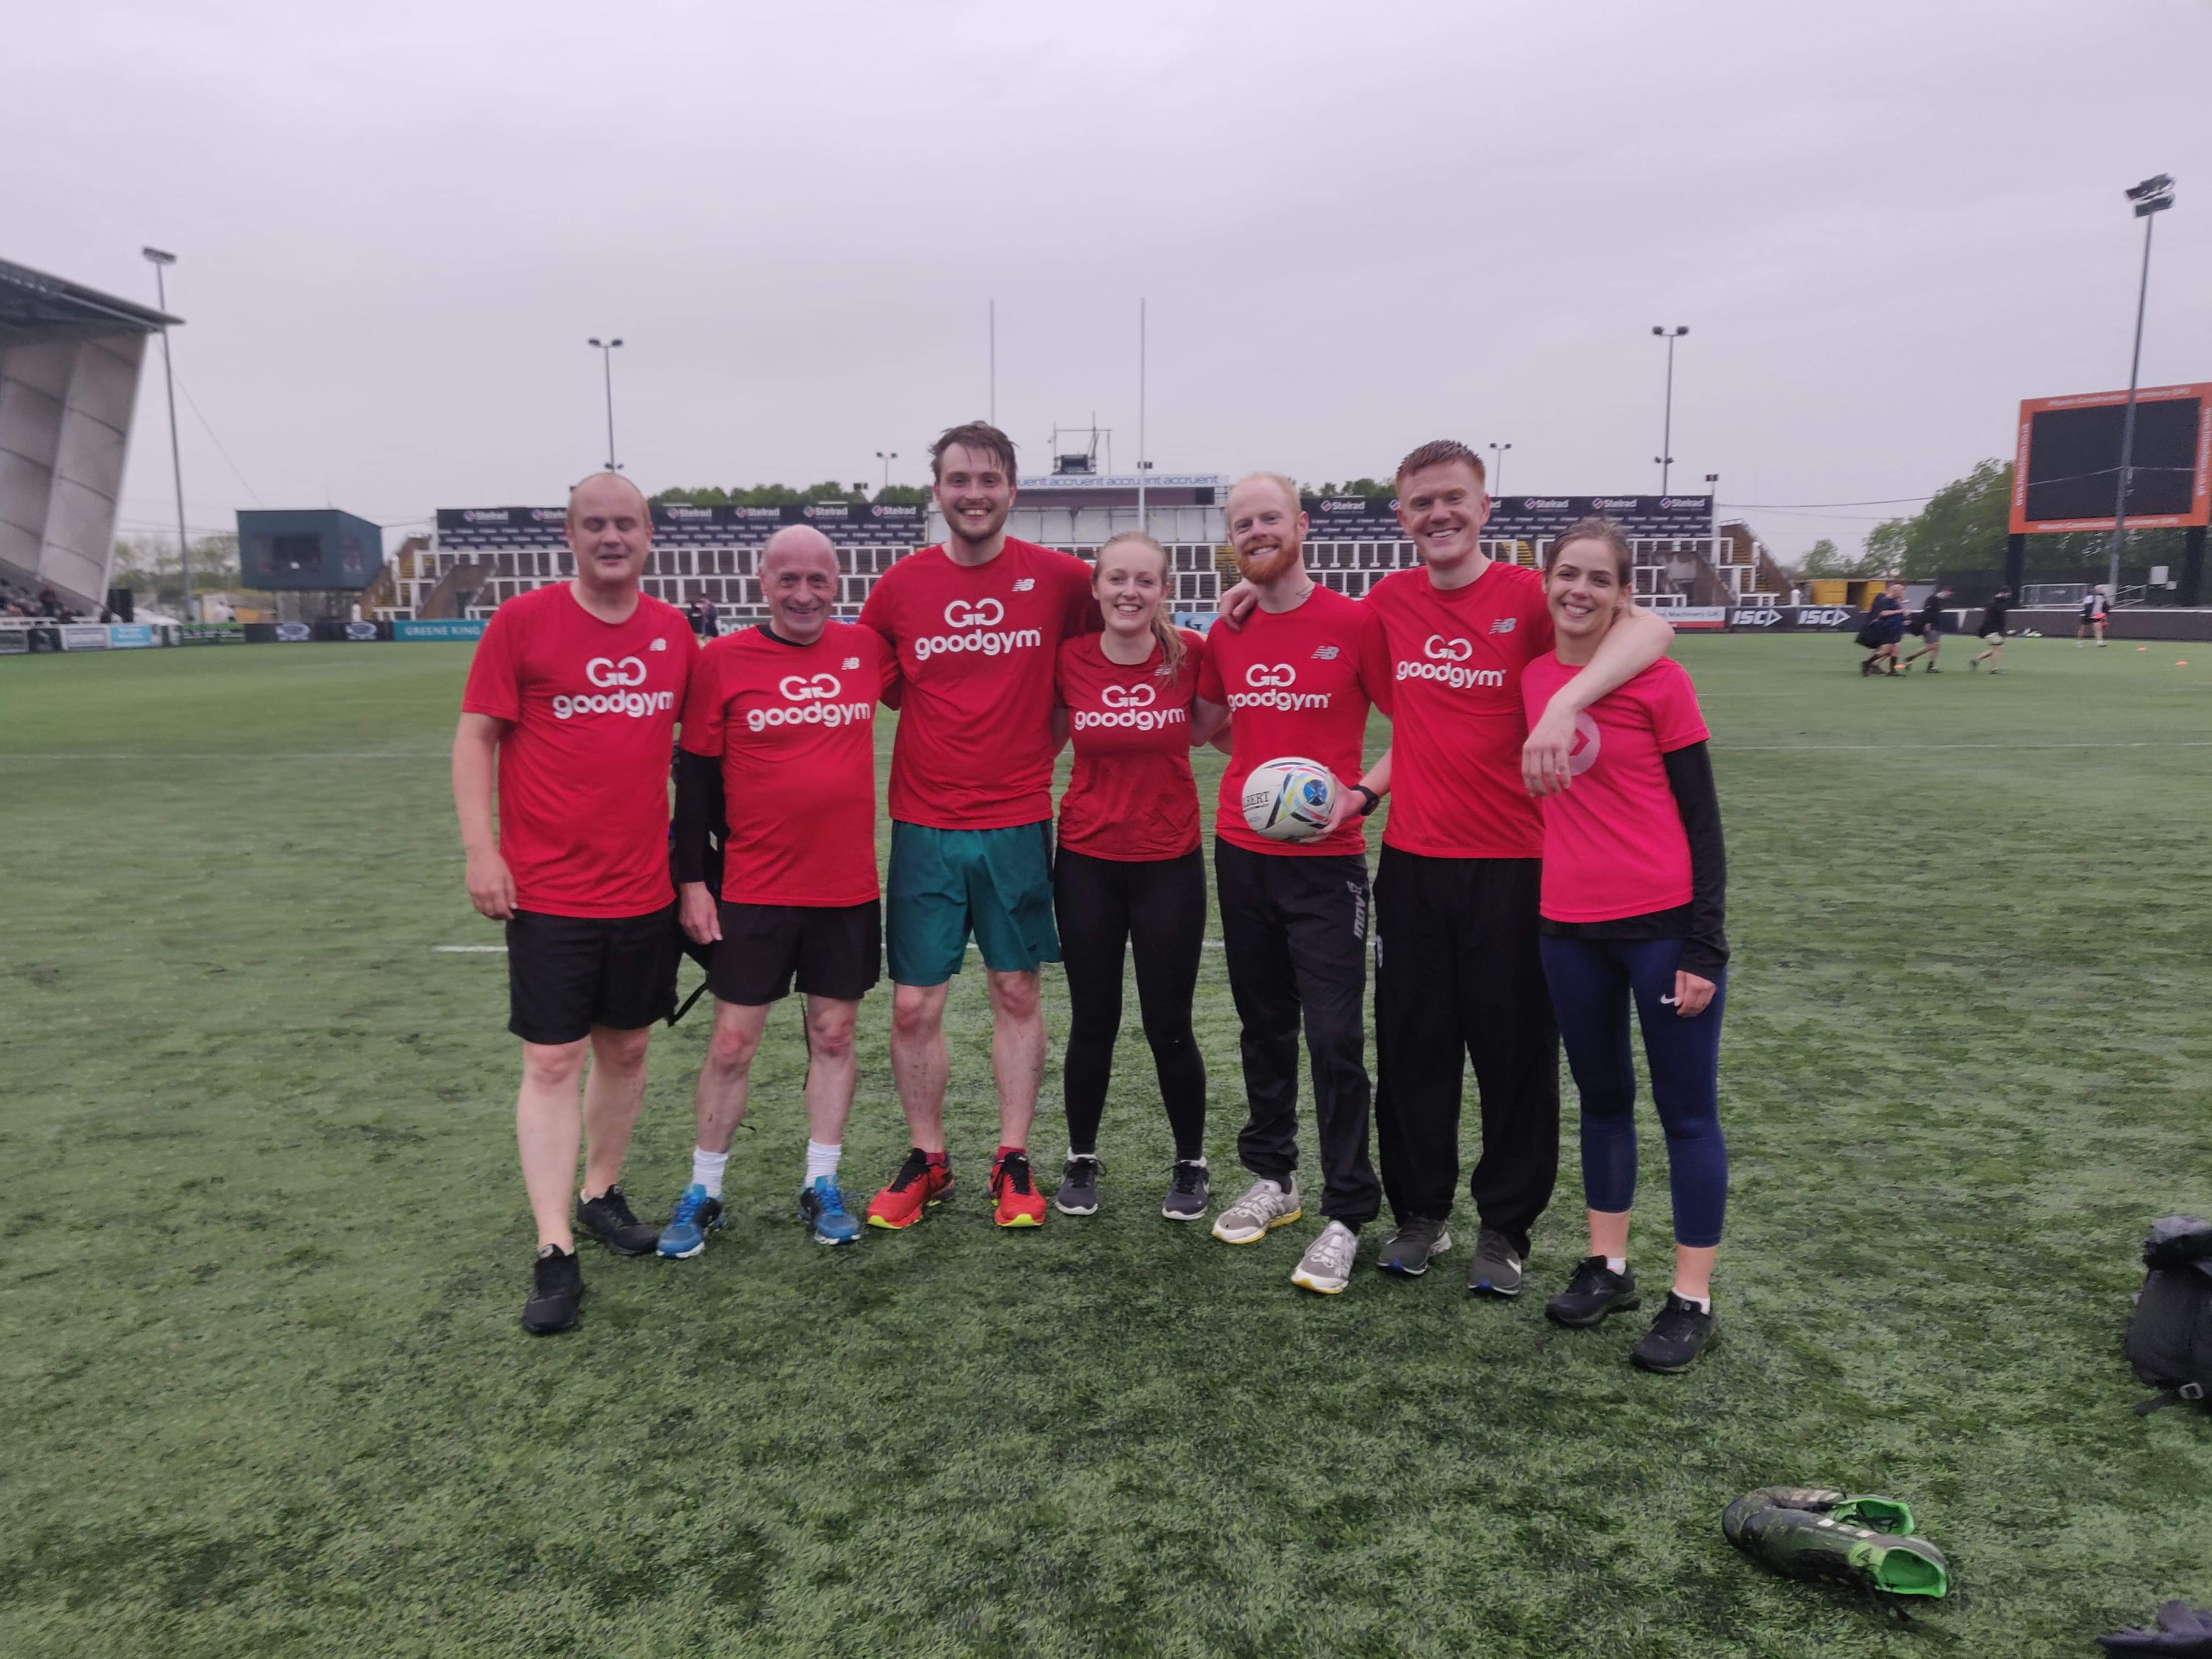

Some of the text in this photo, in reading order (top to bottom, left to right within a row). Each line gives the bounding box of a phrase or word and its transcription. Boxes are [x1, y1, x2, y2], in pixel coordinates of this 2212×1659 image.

[1018, 475, 1220, 487] uent accruent accruent accruent
[883, 506, 917, 515] Stelrad
[1331, 501, 1365, 510] Stelrad
[1536, 500, 1569, 509] Stelrad
[680, 508, 712, 517] Stelrad
[748, 507, 780, 516] Stelrad
[815, 507, 848, 516] Stelrad
[1731, 610, 1768, 625] ISC
[1797, 610, 1835, 625] ISC
[404, 625, 481, 636] GREENE KING
[915, 629, 1041, 661] goodgym
[1396, 660, 1503, 689] goodgym
[553, 689, 674, 720] goodgym
[1227, 689, 1329, 712] goodgym
[747, 701, 871, 732] goodgym
[1074, 708, 1186, 731] goodgym
